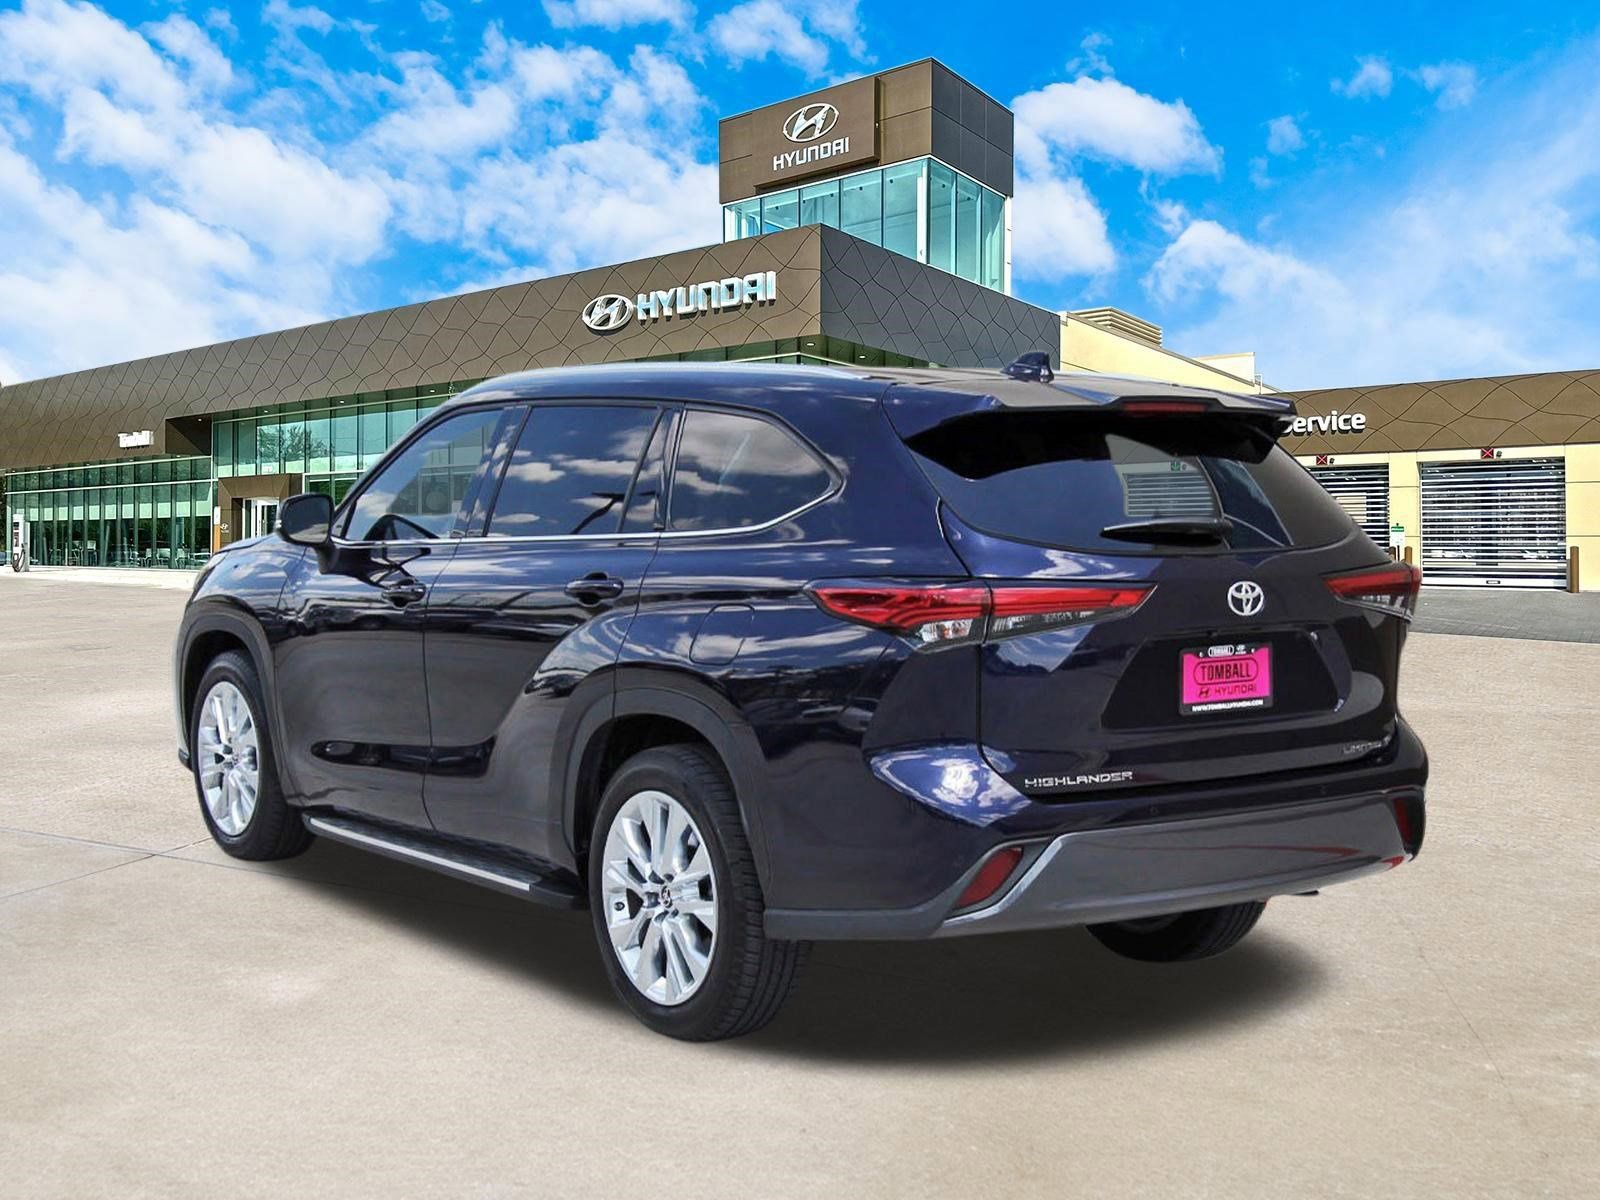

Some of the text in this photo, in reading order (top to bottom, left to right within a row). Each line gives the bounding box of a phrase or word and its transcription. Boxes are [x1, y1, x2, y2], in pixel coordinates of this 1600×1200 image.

[773, 137, 849, 171] HYUNDAI
[637, 270, 777, 320] HYUNDAI
[1283, 410, 1366, 433] ervice
[1200, 663, 1250, 681] TOMBALL
[1214, 684, 1257, 696] HYUNDAI
[1024, 771, 1133, 788] HIGHLANDER
